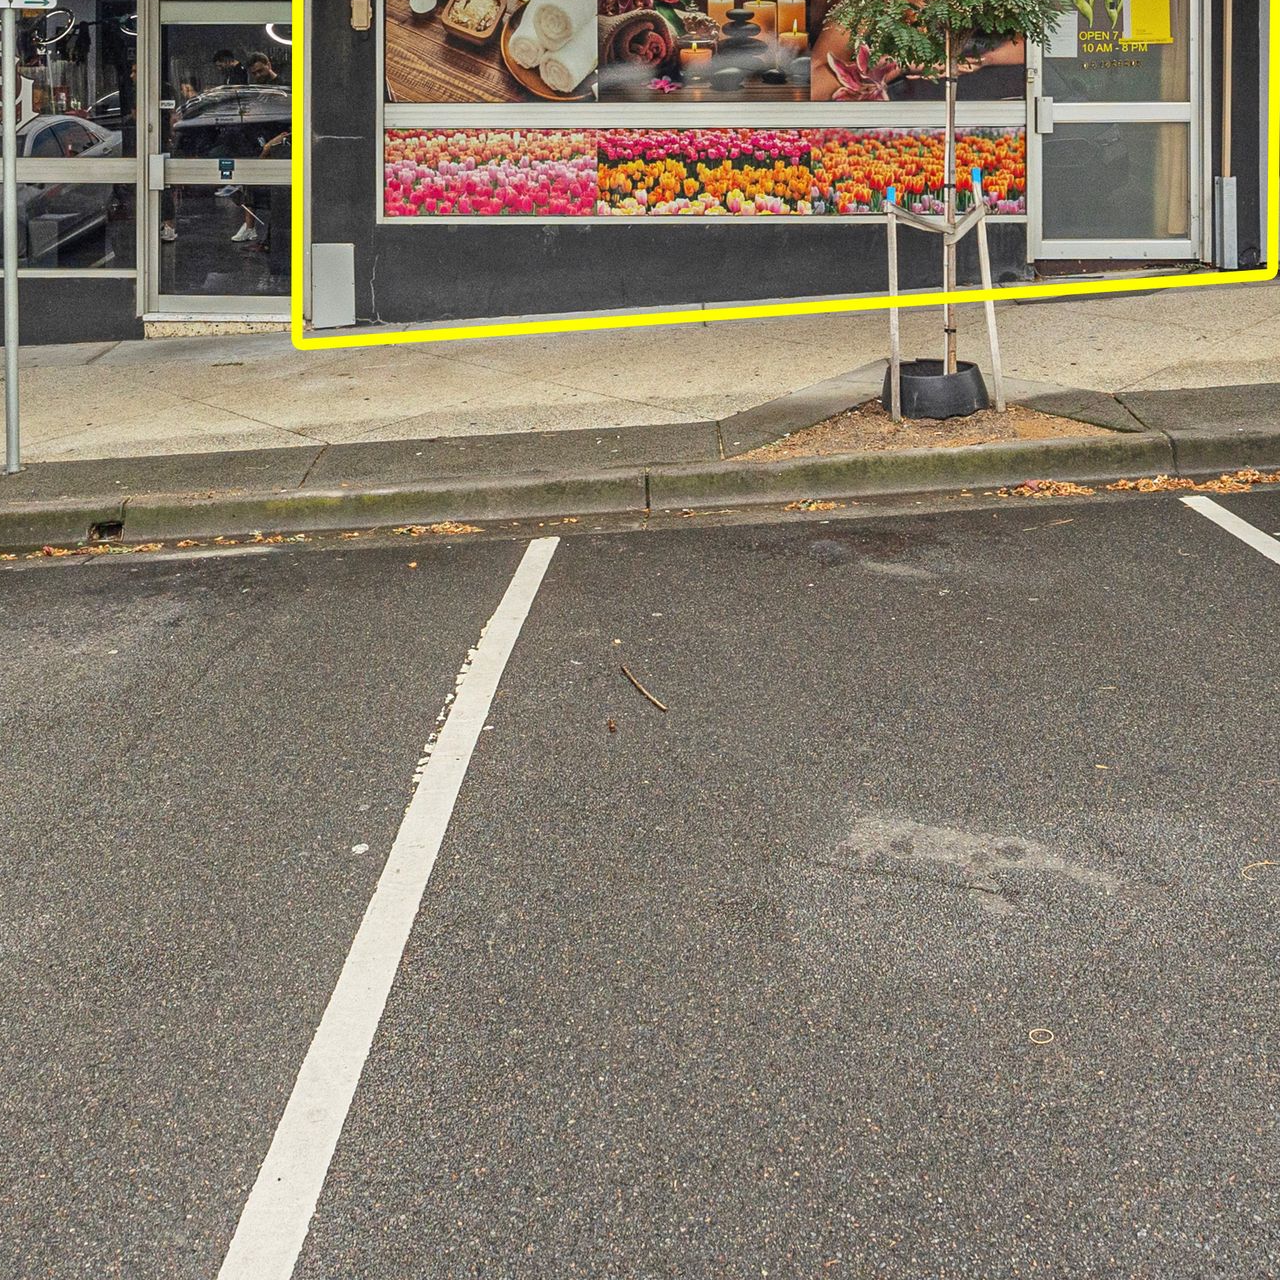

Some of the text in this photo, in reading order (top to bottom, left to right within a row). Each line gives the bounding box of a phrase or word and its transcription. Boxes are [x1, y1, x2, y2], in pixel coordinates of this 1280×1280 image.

[1079, 31, 1110, 41] OPEN
[1113, 31, 1119, 40] 7
[1083, 43, 1094, 53] 10
[1096, 43, 1113, 52] AM
[1122, 42, 1129, 52] 8
[1132, 42, 1148, 52] PM
